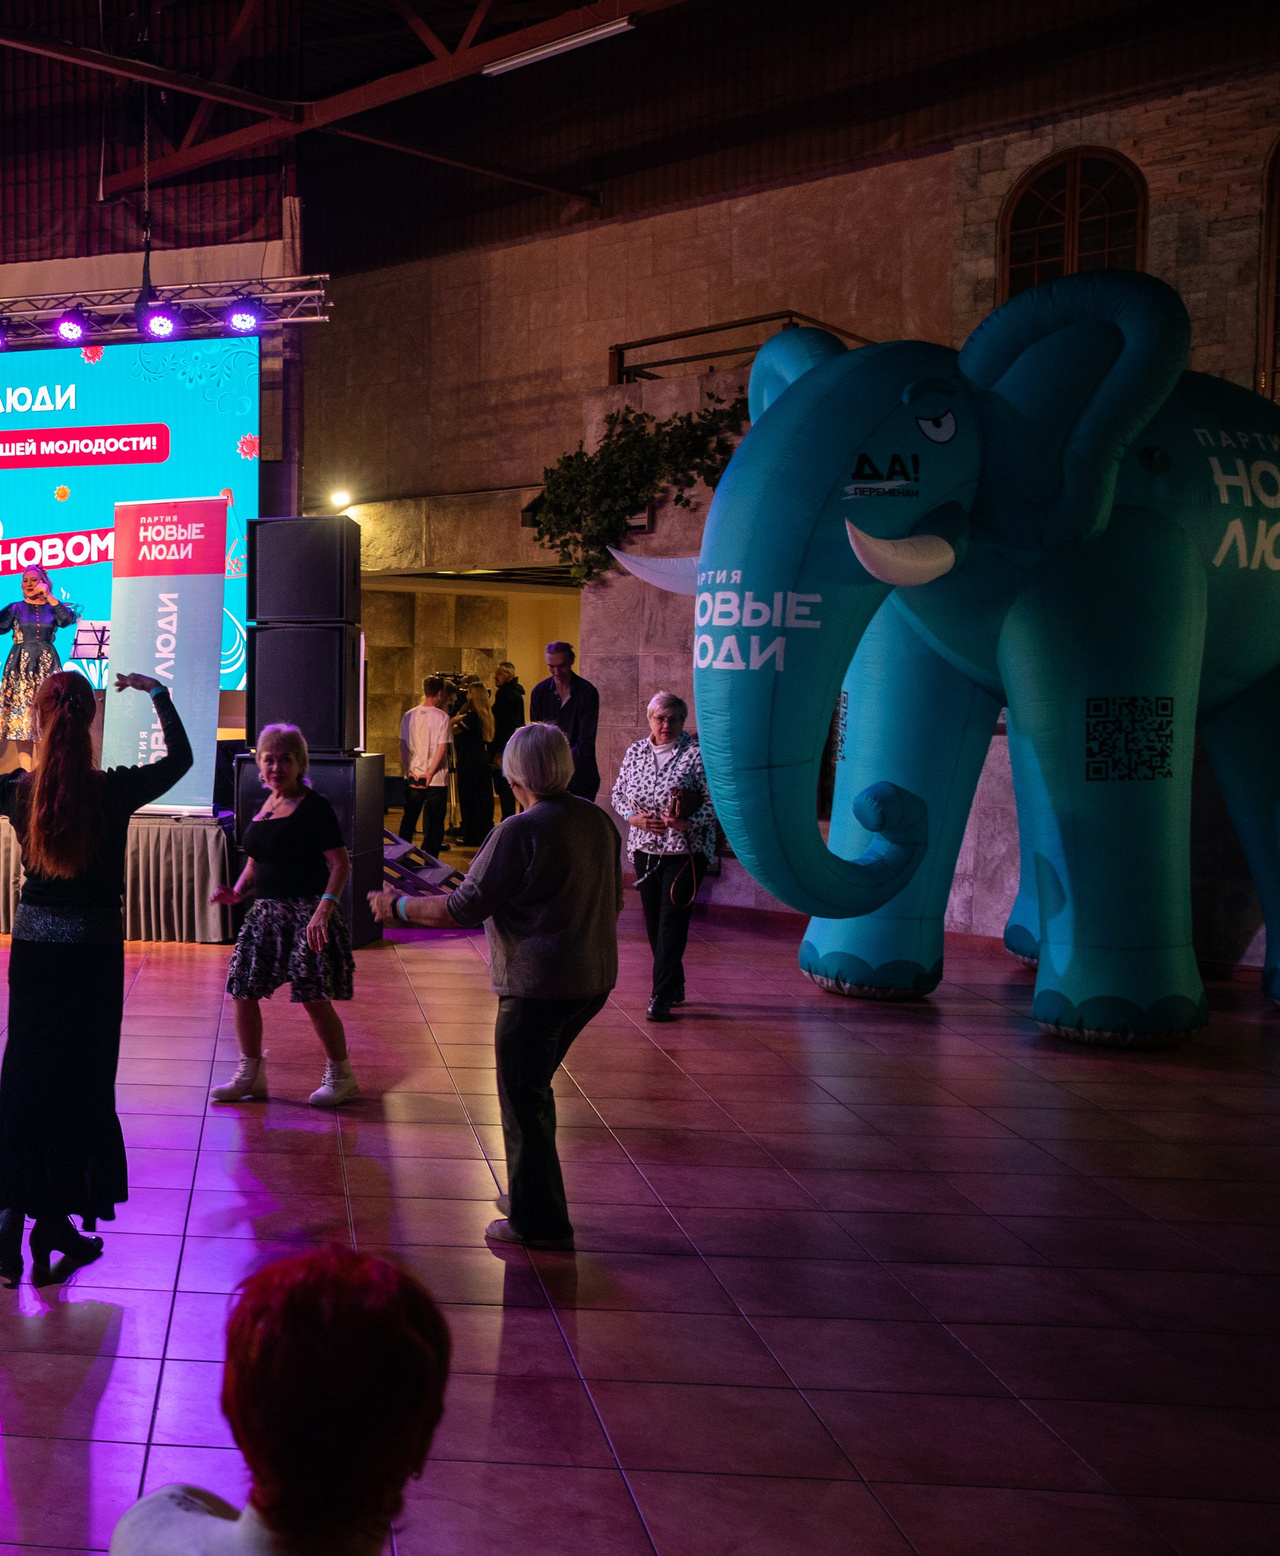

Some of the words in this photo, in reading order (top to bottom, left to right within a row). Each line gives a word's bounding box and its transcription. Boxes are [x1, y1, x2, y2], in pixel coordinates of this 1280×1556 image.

[40, 436, 157, 455] МОЛОДОСТИ!
[1194, 428, 1280, 451] ПАРТИ
[851, 453, 919, 482] ДА!
[853, 487, 919, 499] ПЕРЕМЕНАМ
[1208, 457, 1280, 509] НО
[139, 523, 205, 542] НОВЫЕ
[140, 515, 178, 524] ПАРТИЯ
[138, 543, 193, 561] ЛЮДИ
[1212, 518, 1280, 571] ЛЮ
[697, 570, 742, 586] РТИЯ
[695, 591, 822, 629] ОВЫЕ
[154, 593, 179, 680] ЛЮДИ
[693, 634, 786, 672] ЮДИ
[137, 731, 148, 768] РТИЯ
